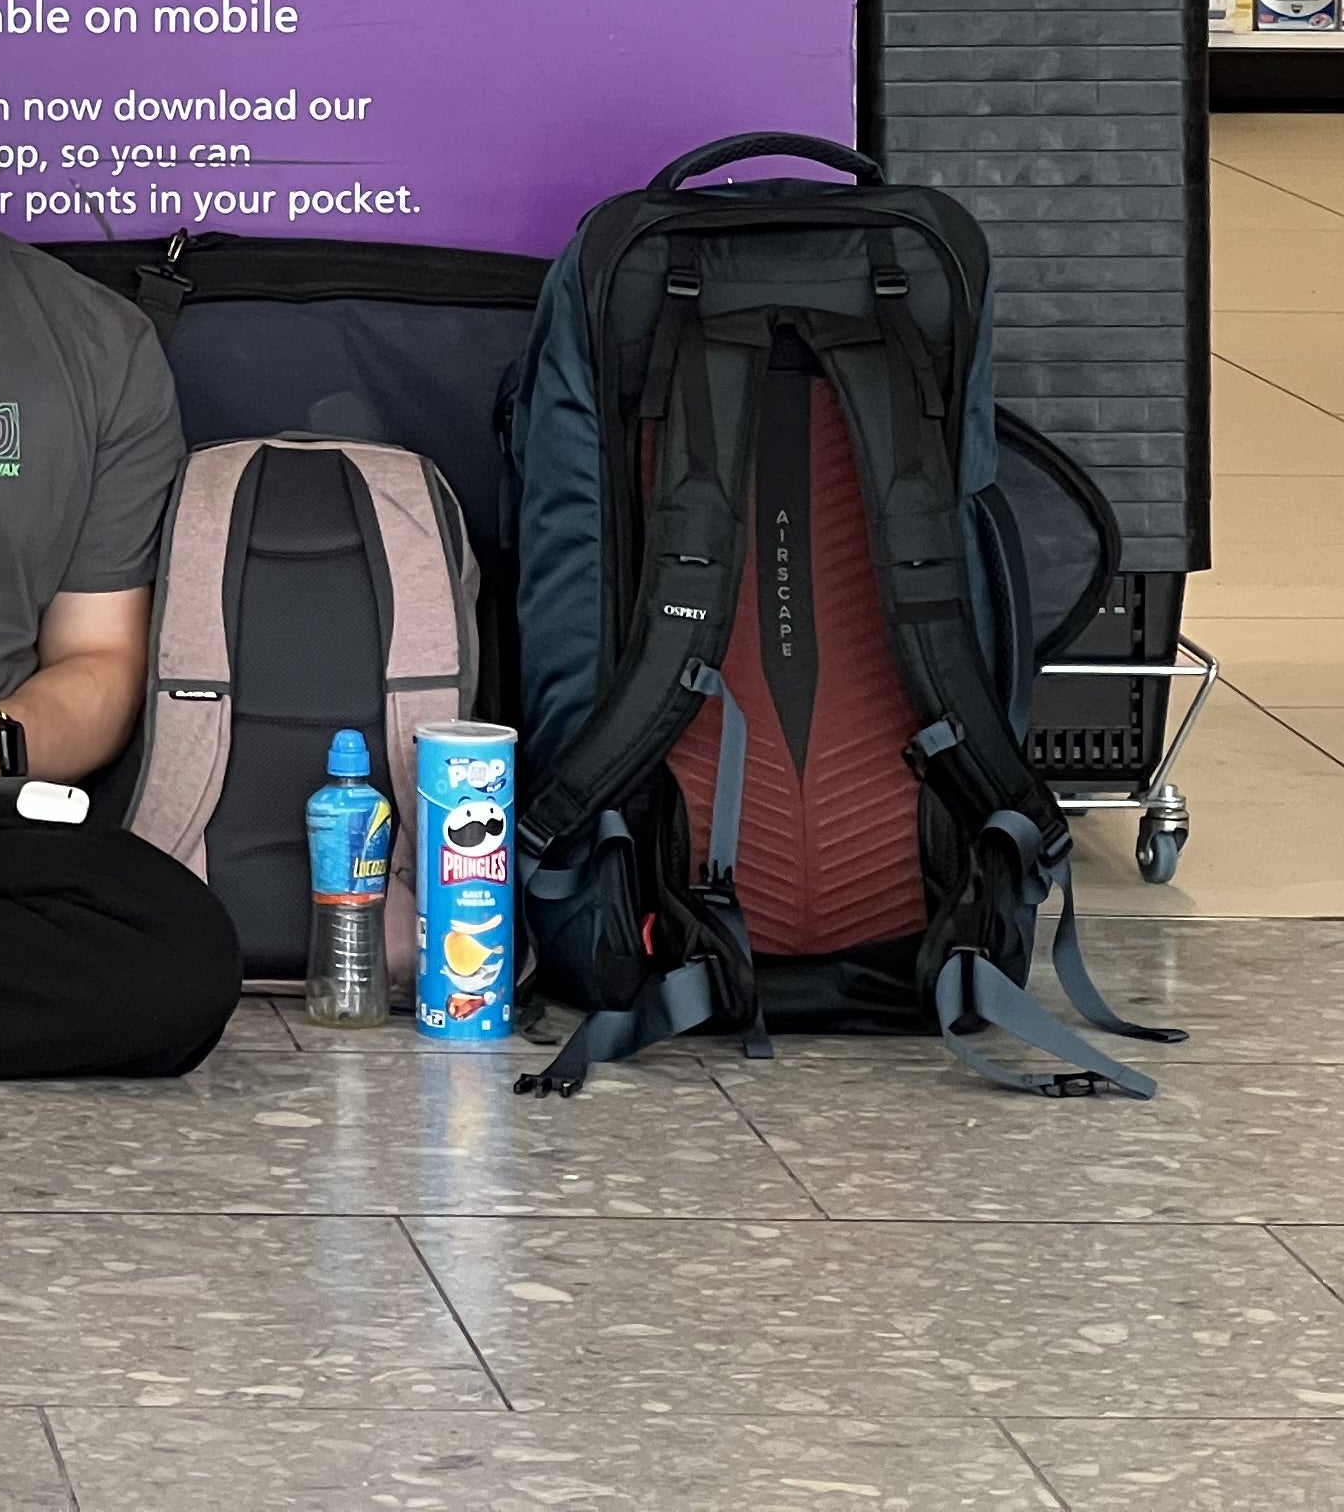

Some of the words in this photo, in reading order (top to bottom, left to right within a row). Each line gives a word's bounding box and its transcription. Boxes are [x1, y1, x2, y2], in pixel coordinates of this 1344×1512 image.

[85, 7, 137, 34] on
[24, 98, 103, 121] now
[114, 88, 296, 121] download
[309, 97, 372, 121] our
[61, 145, 99, 168] so
[111, 144, 176, 176] you
[189, 144, 250, 168] can
[26, 186, 137, 222] points
[150, 183, 181, 214] in
[193, 190, 277, 222] your
[289, 181, 420, 221] pocket.
[776, 509, 793, 657] AIRSCAPE
[663, 604, 707, 620] OSPREY
[443, 849, 506, 882] PRINGLES
